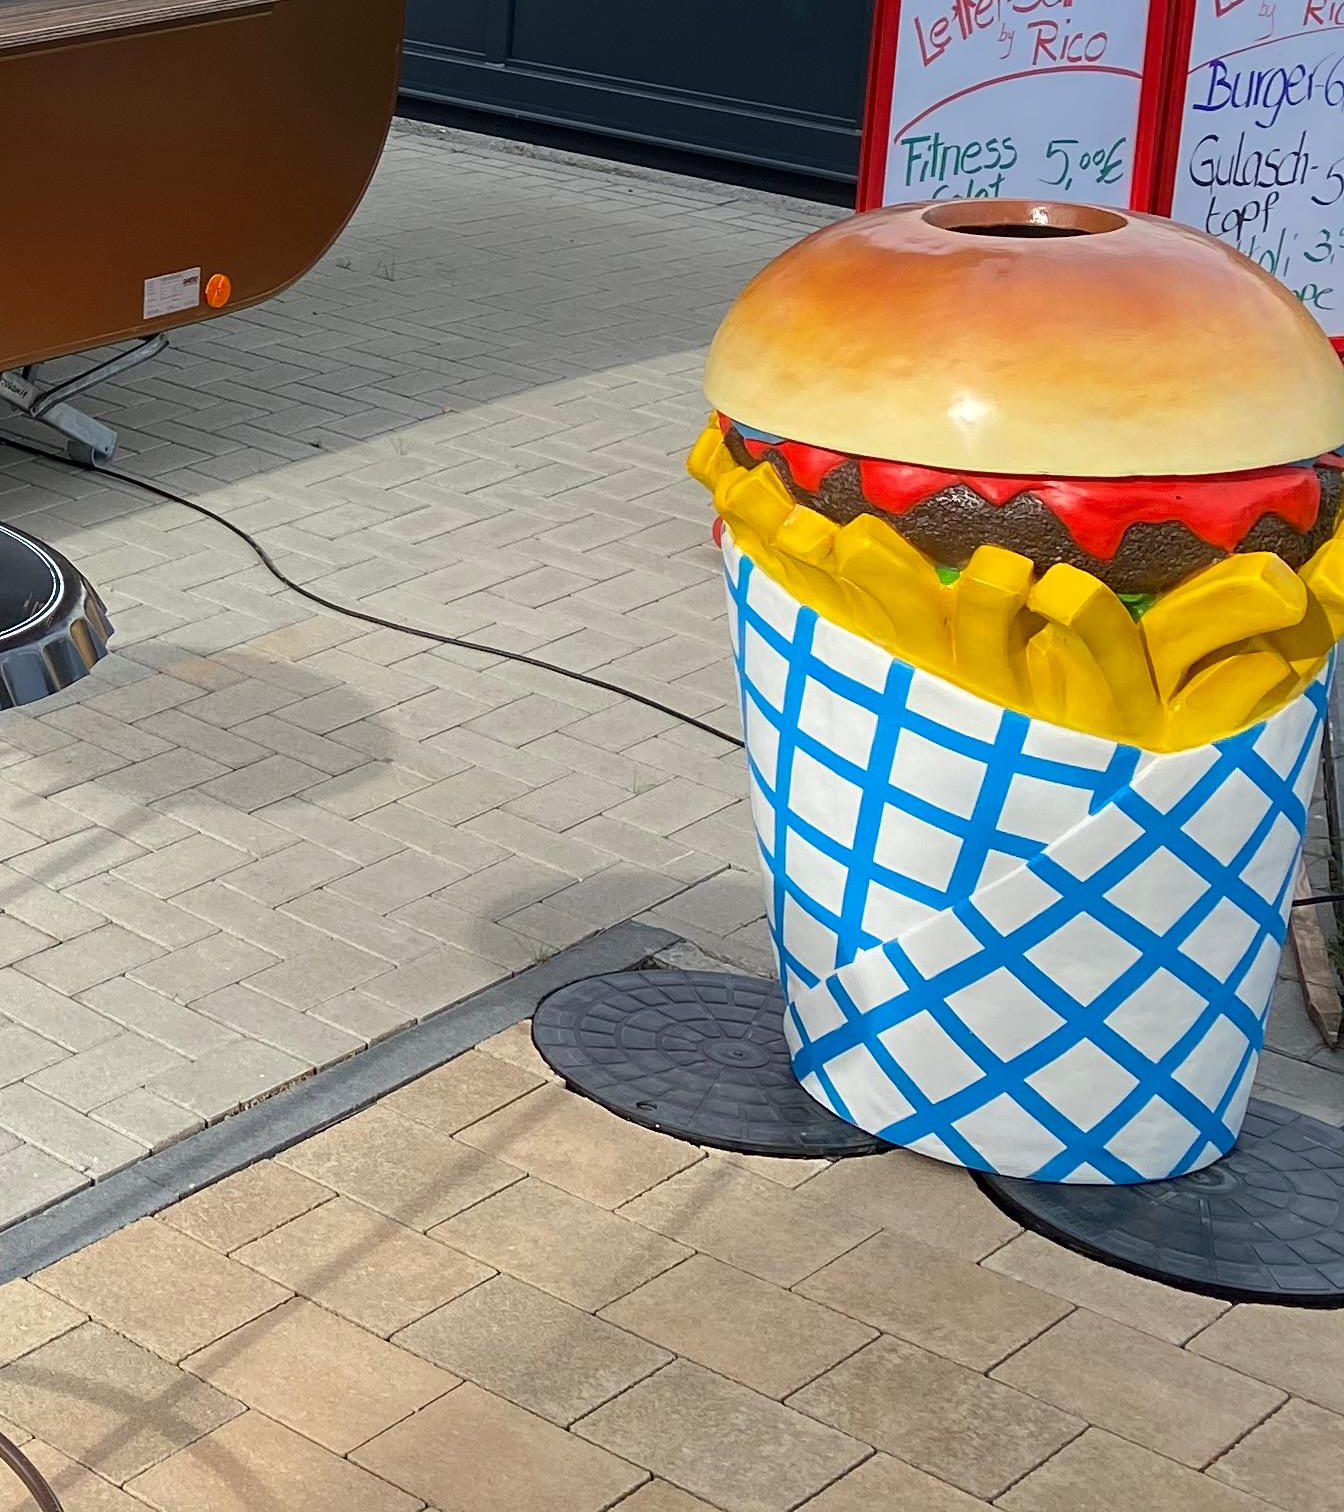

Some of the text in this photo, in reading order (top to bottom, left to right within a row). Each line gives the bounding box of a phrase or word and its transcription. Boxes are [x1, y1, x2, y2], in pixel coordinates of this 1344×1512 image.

[997, 18, 1109, 66] by Rico
[901, 132, 1018, 187] Fitness
[1038, 136, 1127, 191] 5,00€
[1205, 190, 1280, 242] topf
